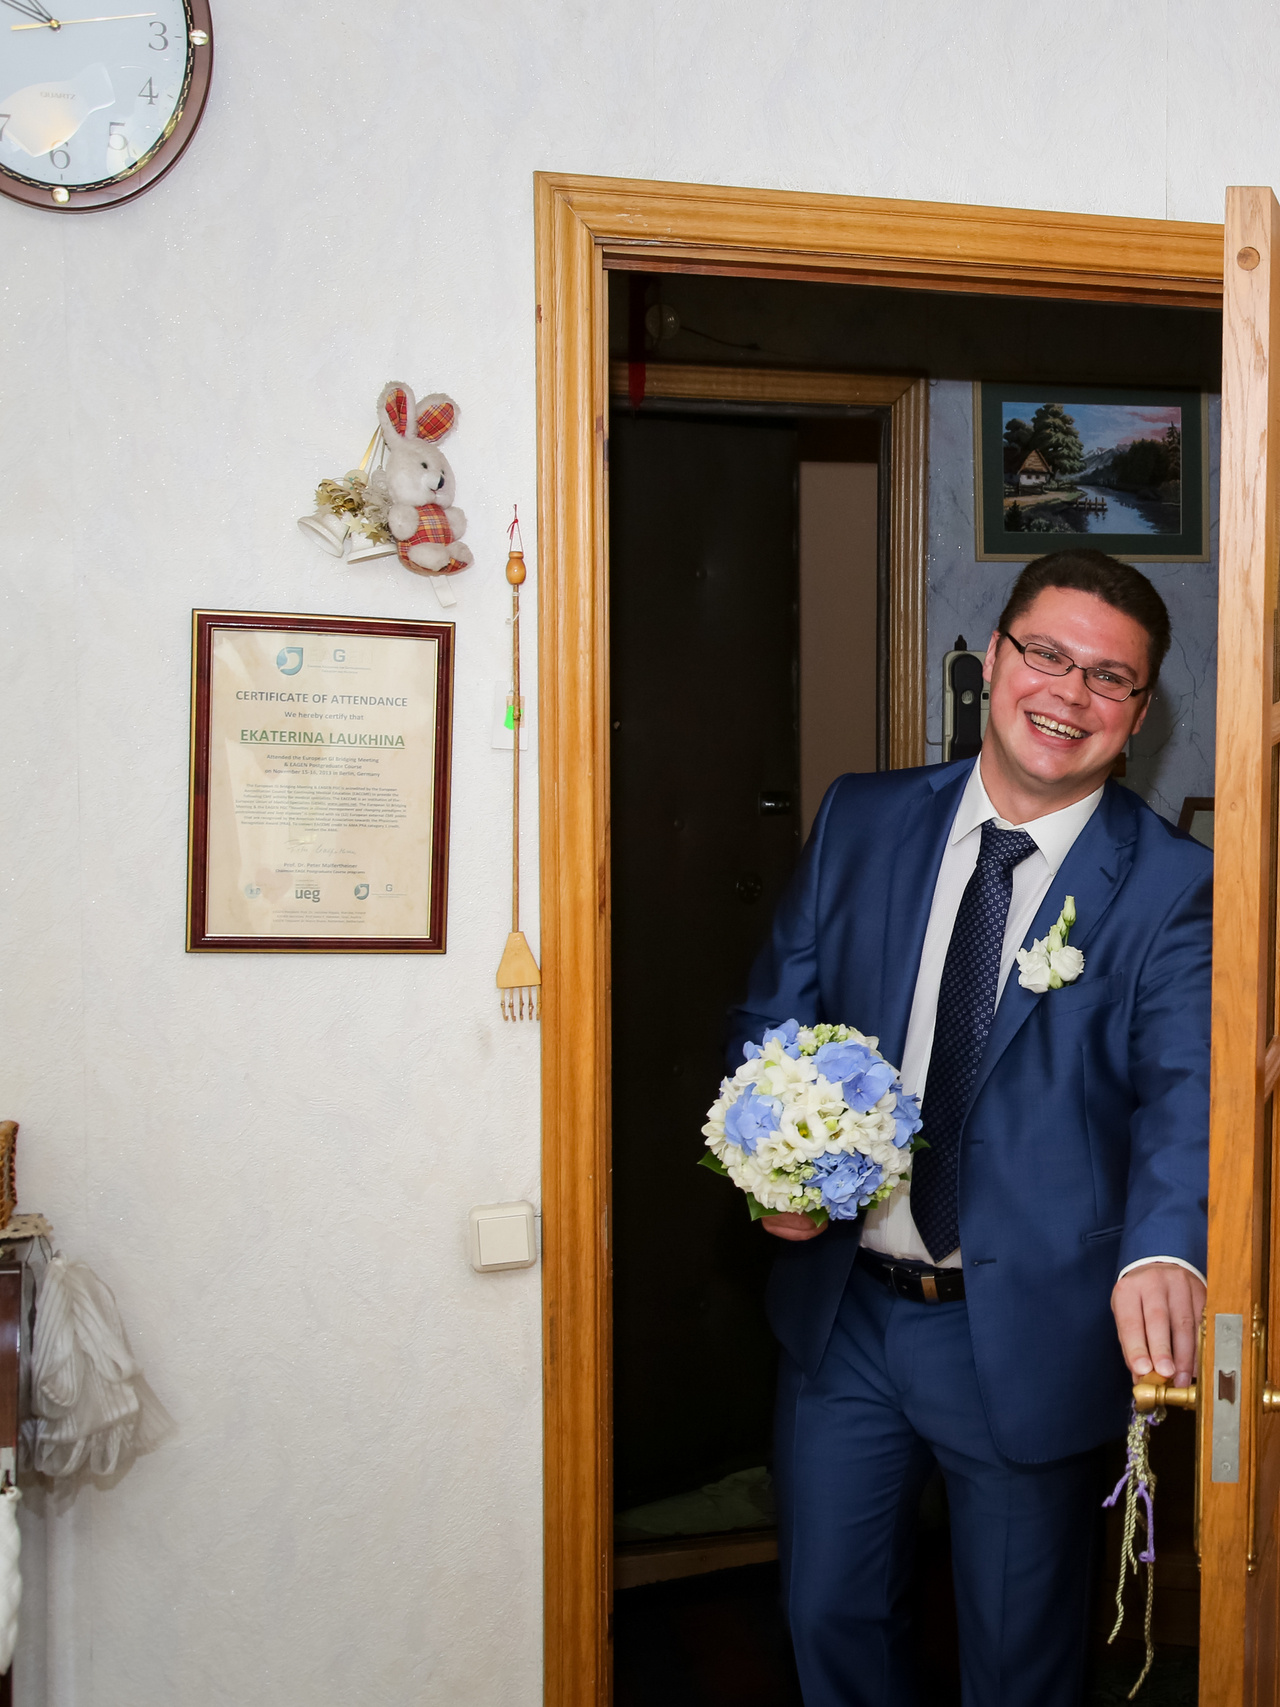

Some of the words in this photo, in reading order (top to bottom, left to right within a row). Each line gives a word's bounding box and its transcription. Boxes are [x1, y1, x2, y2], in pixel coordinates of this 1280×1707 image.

[148, 21, 169, 51] 3
[40, 91, 76, 100] QUARTZ
[138, 76, 159, 106] 4
[108, 122, 128, 150] 5
[50, 139, 71, 170] 6
[236, 690, 309, 703] CERTIFICATE
[312, 693, 328, 704] OF
[330, 695, 408, 707] ATTENDANCE
[298, 711, 323, 720] hereby
[325, 713, 348, 721] certify
[240, 729, 325, 744] EKATERINA
[329, 732, 405, 747] LAUKHINA
[295, 888, 321, 903] ueg
